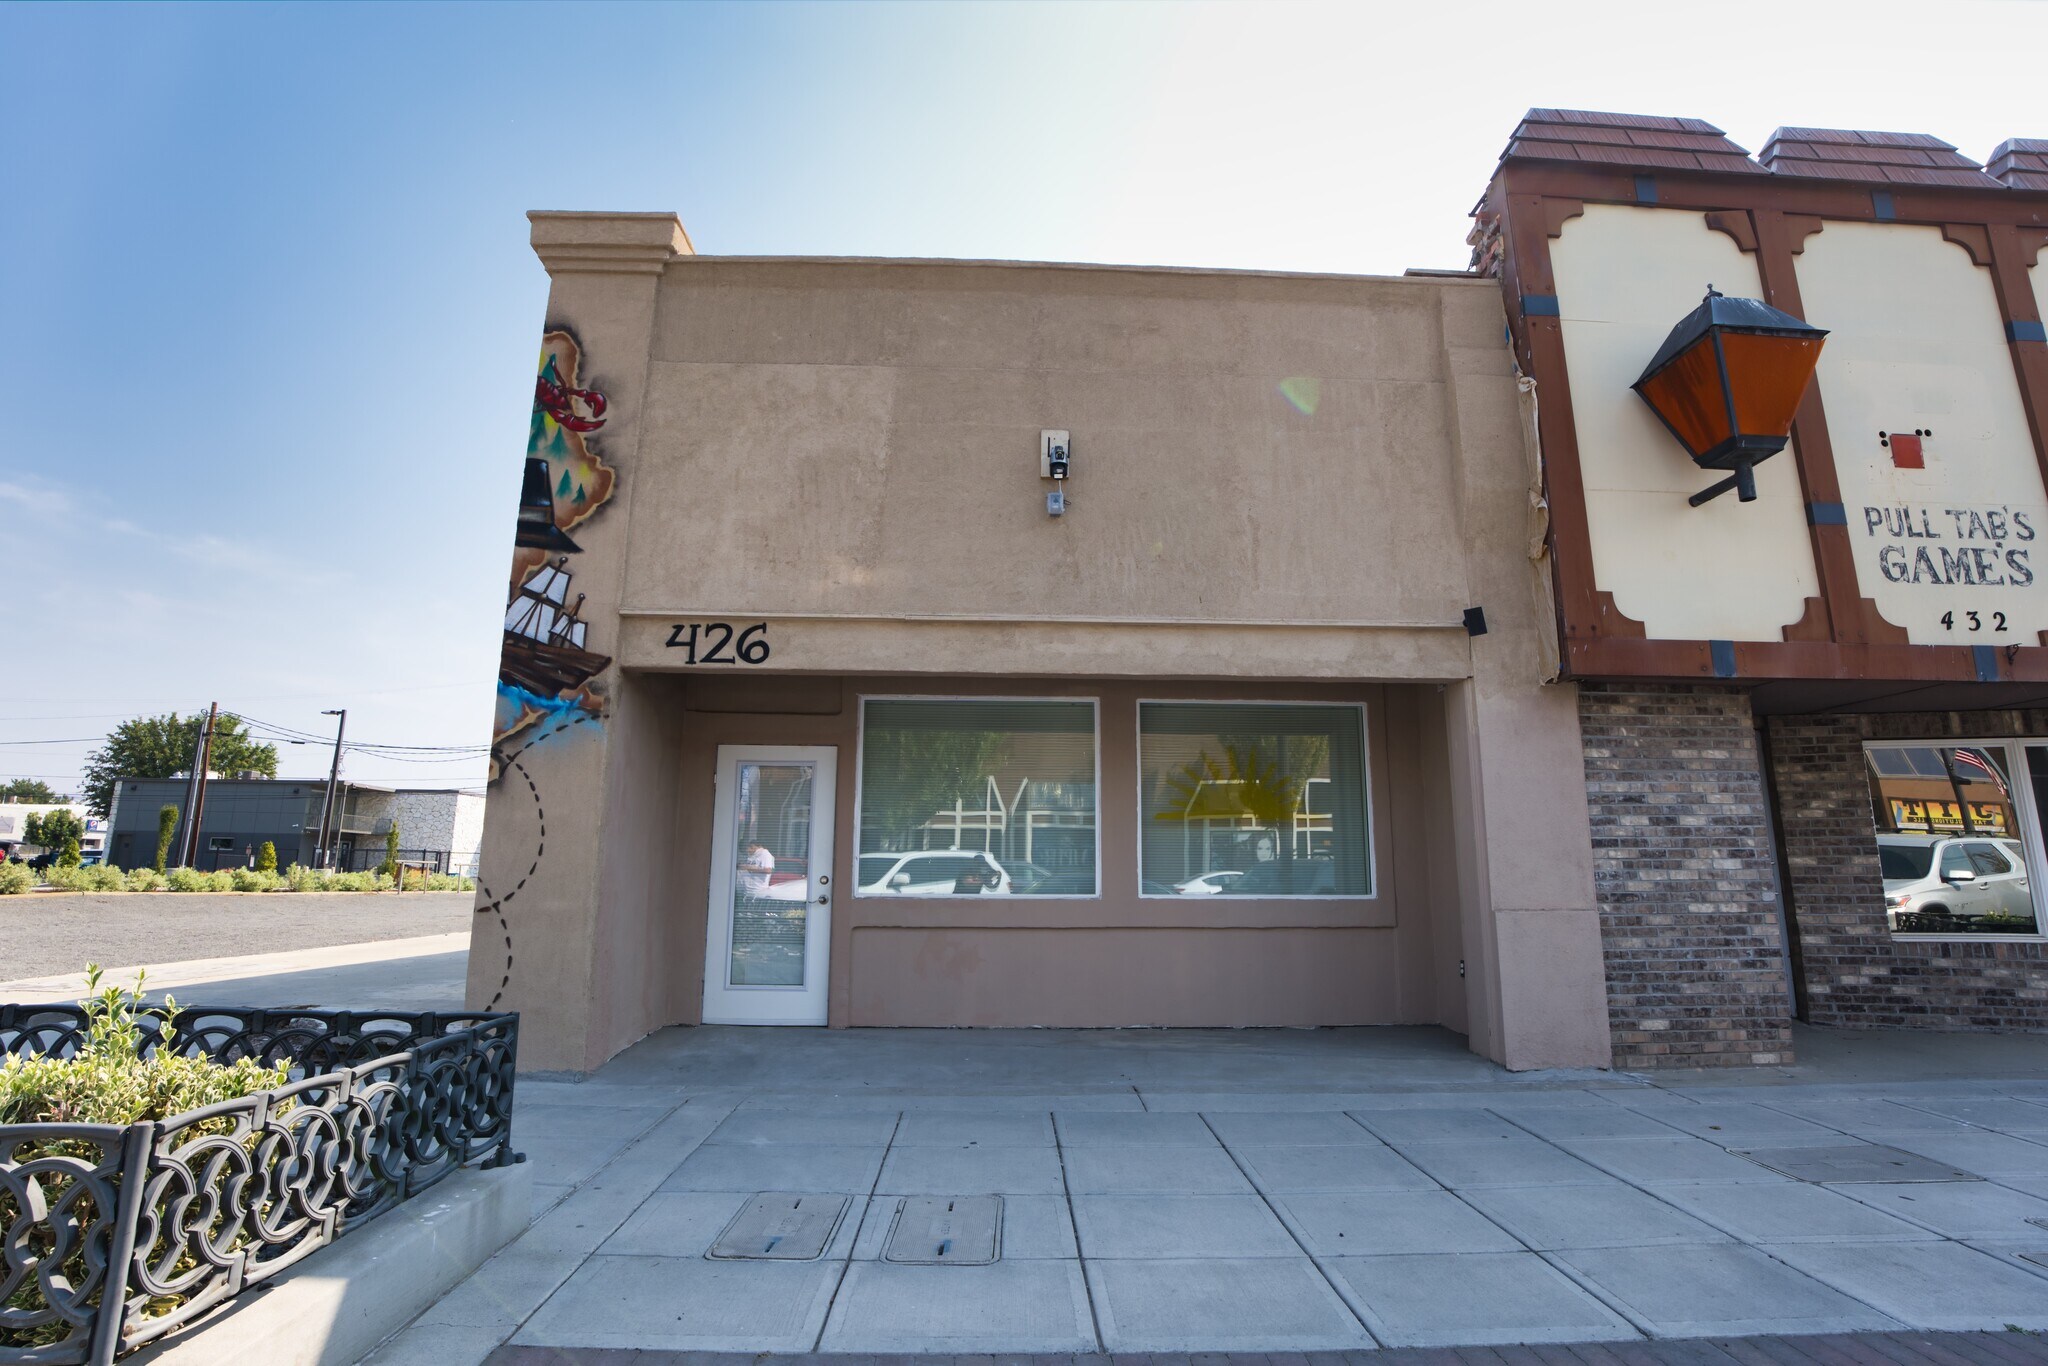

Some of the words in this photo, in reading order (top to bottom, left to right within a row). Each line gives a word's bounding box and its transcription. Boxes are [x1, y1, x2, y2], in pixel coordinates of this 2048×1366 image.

[1864, 506, 1940, 538] PULL
[1940, 610, 2008, 632] 432
[665, 622, 770, 664] 426
